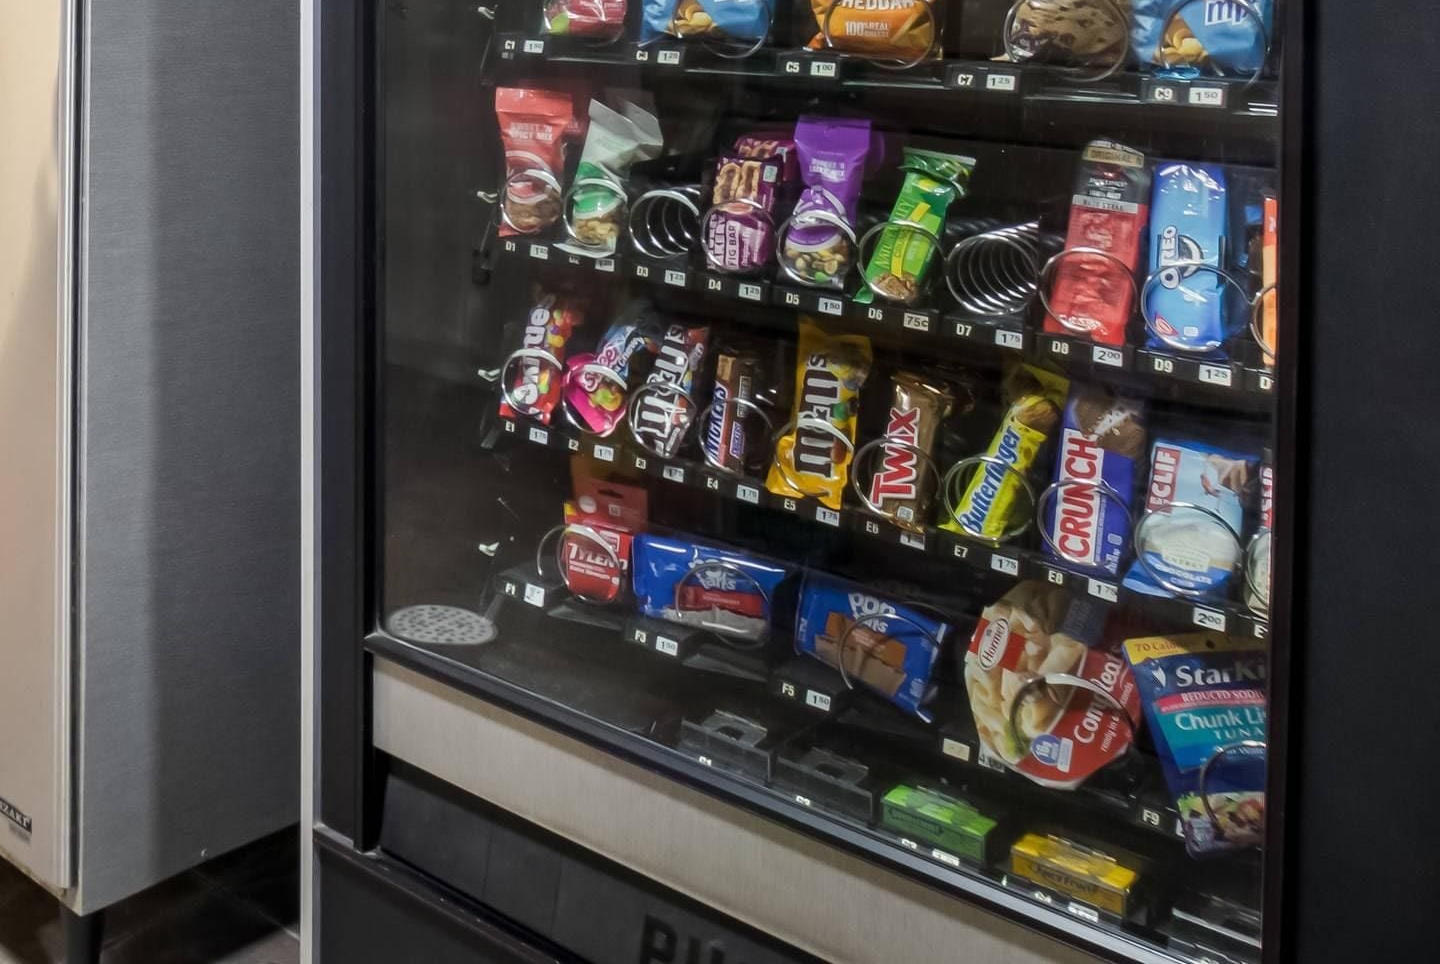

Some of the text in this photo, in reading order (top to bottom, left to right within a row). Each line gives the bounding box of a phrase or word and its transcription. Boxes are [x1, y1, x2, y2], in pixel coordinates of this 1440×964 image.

[709, 280, 721, 290] D4
[786, 293, 799, 305] D5
[869, 308, 883, 320] D6
[956, 323, 972, 336] D7
[1052, 340, 1069, 354] D8
[1154, 359, 1173, 372] D9
[707, 479, 718, 490] E4
[960, 425, 1021, 534] Butterfinger
[1059, 437, 1098, 558] CRUNCH
[784, 500, 796, 511] E5
[866, 521, 879, 533] E6
[954, 546, 968, 557] E7
[1048, 570, 1064, 584] E8
[505, 583, 516, 596] F1
[983, 622, 1007, 662] Hormel
[782, 682, 795, 696] F5
[1175, 709, 1243, 730] Chunk
[1142, 810, 1160, 826] F9
